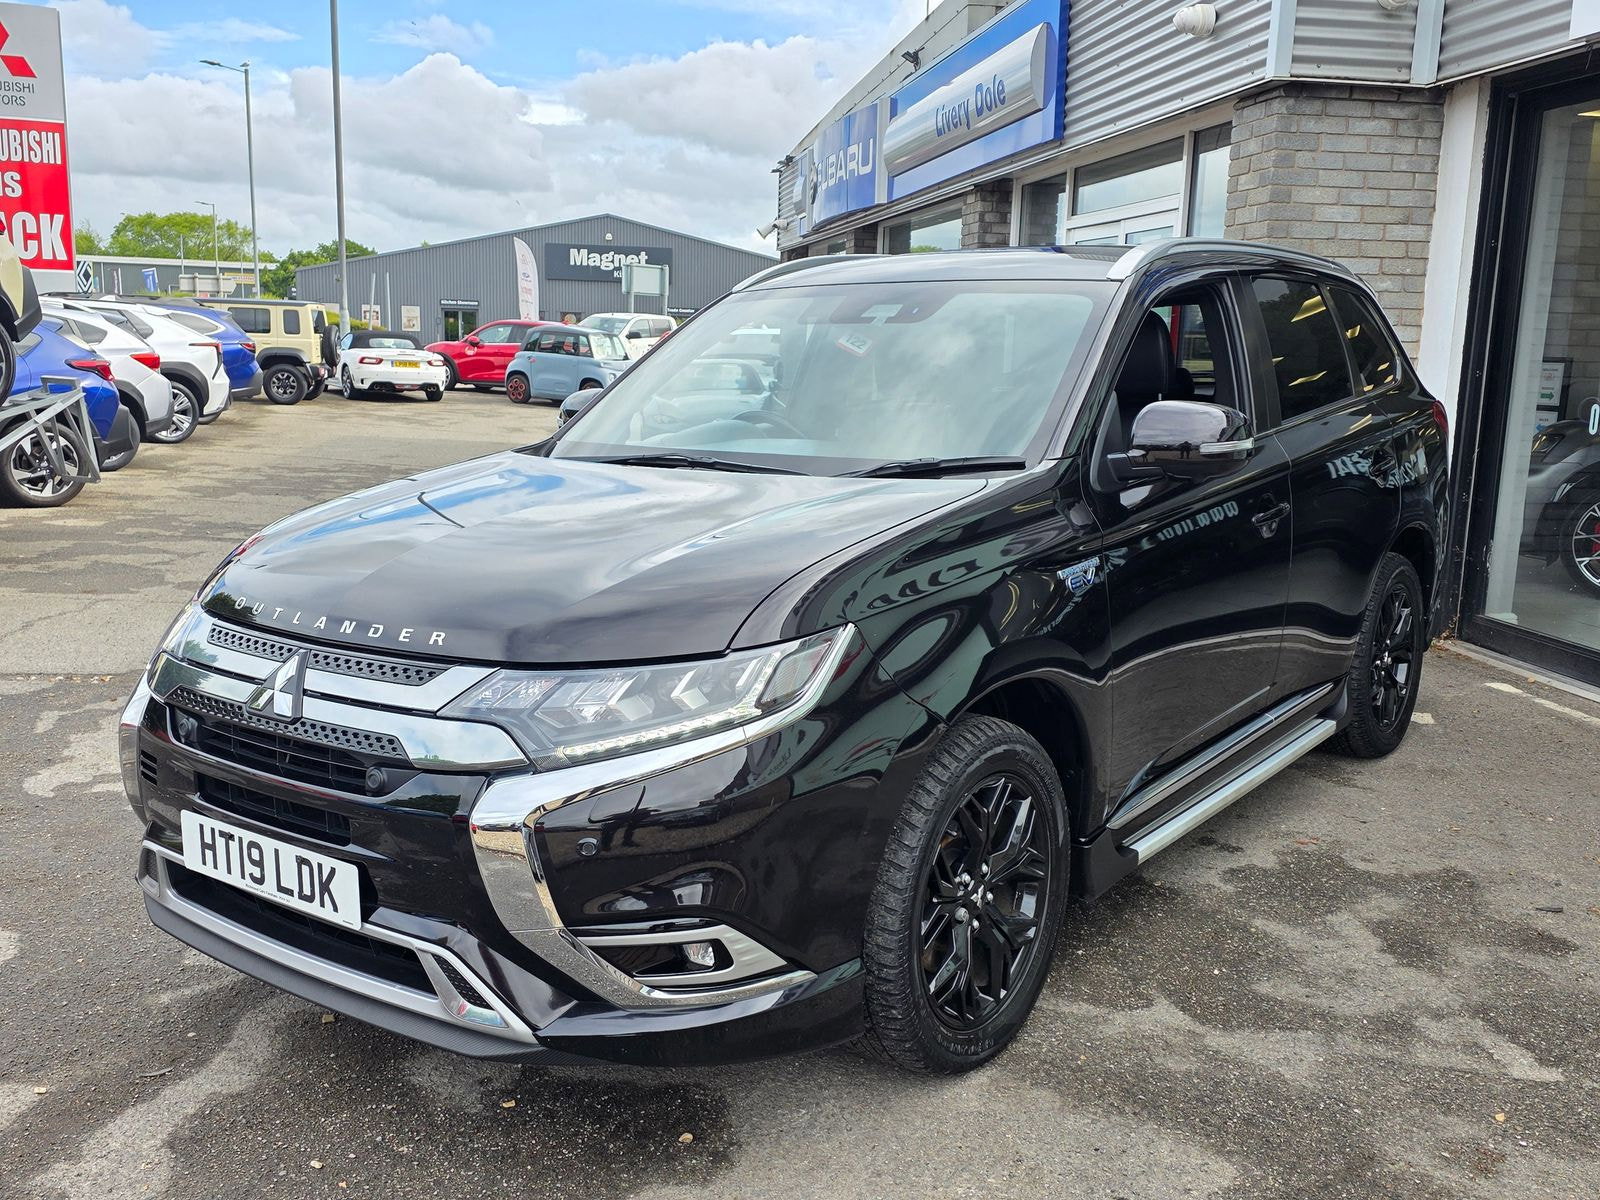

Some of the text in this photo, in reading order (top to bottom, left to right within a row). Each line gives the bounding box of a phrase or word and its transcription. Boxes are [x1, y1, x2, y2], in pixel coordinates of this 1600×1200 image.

[0, 81, 35, 94] BISHI
[0, 94, 26, 106] ORS
[935, 74, 1006, 137] Livery Dole
[816, 138, 873, 192] SUBARU
[0, 211, 68, 261] CK
[569, 248, 648, 271] Magnet
[613, 270, 623, 278] Ki
[1065, 567, 1096, 594] EV
[234, 595, 448, 646] OUTLANDER
[198, 822, 340, 913] HT19 LDK
